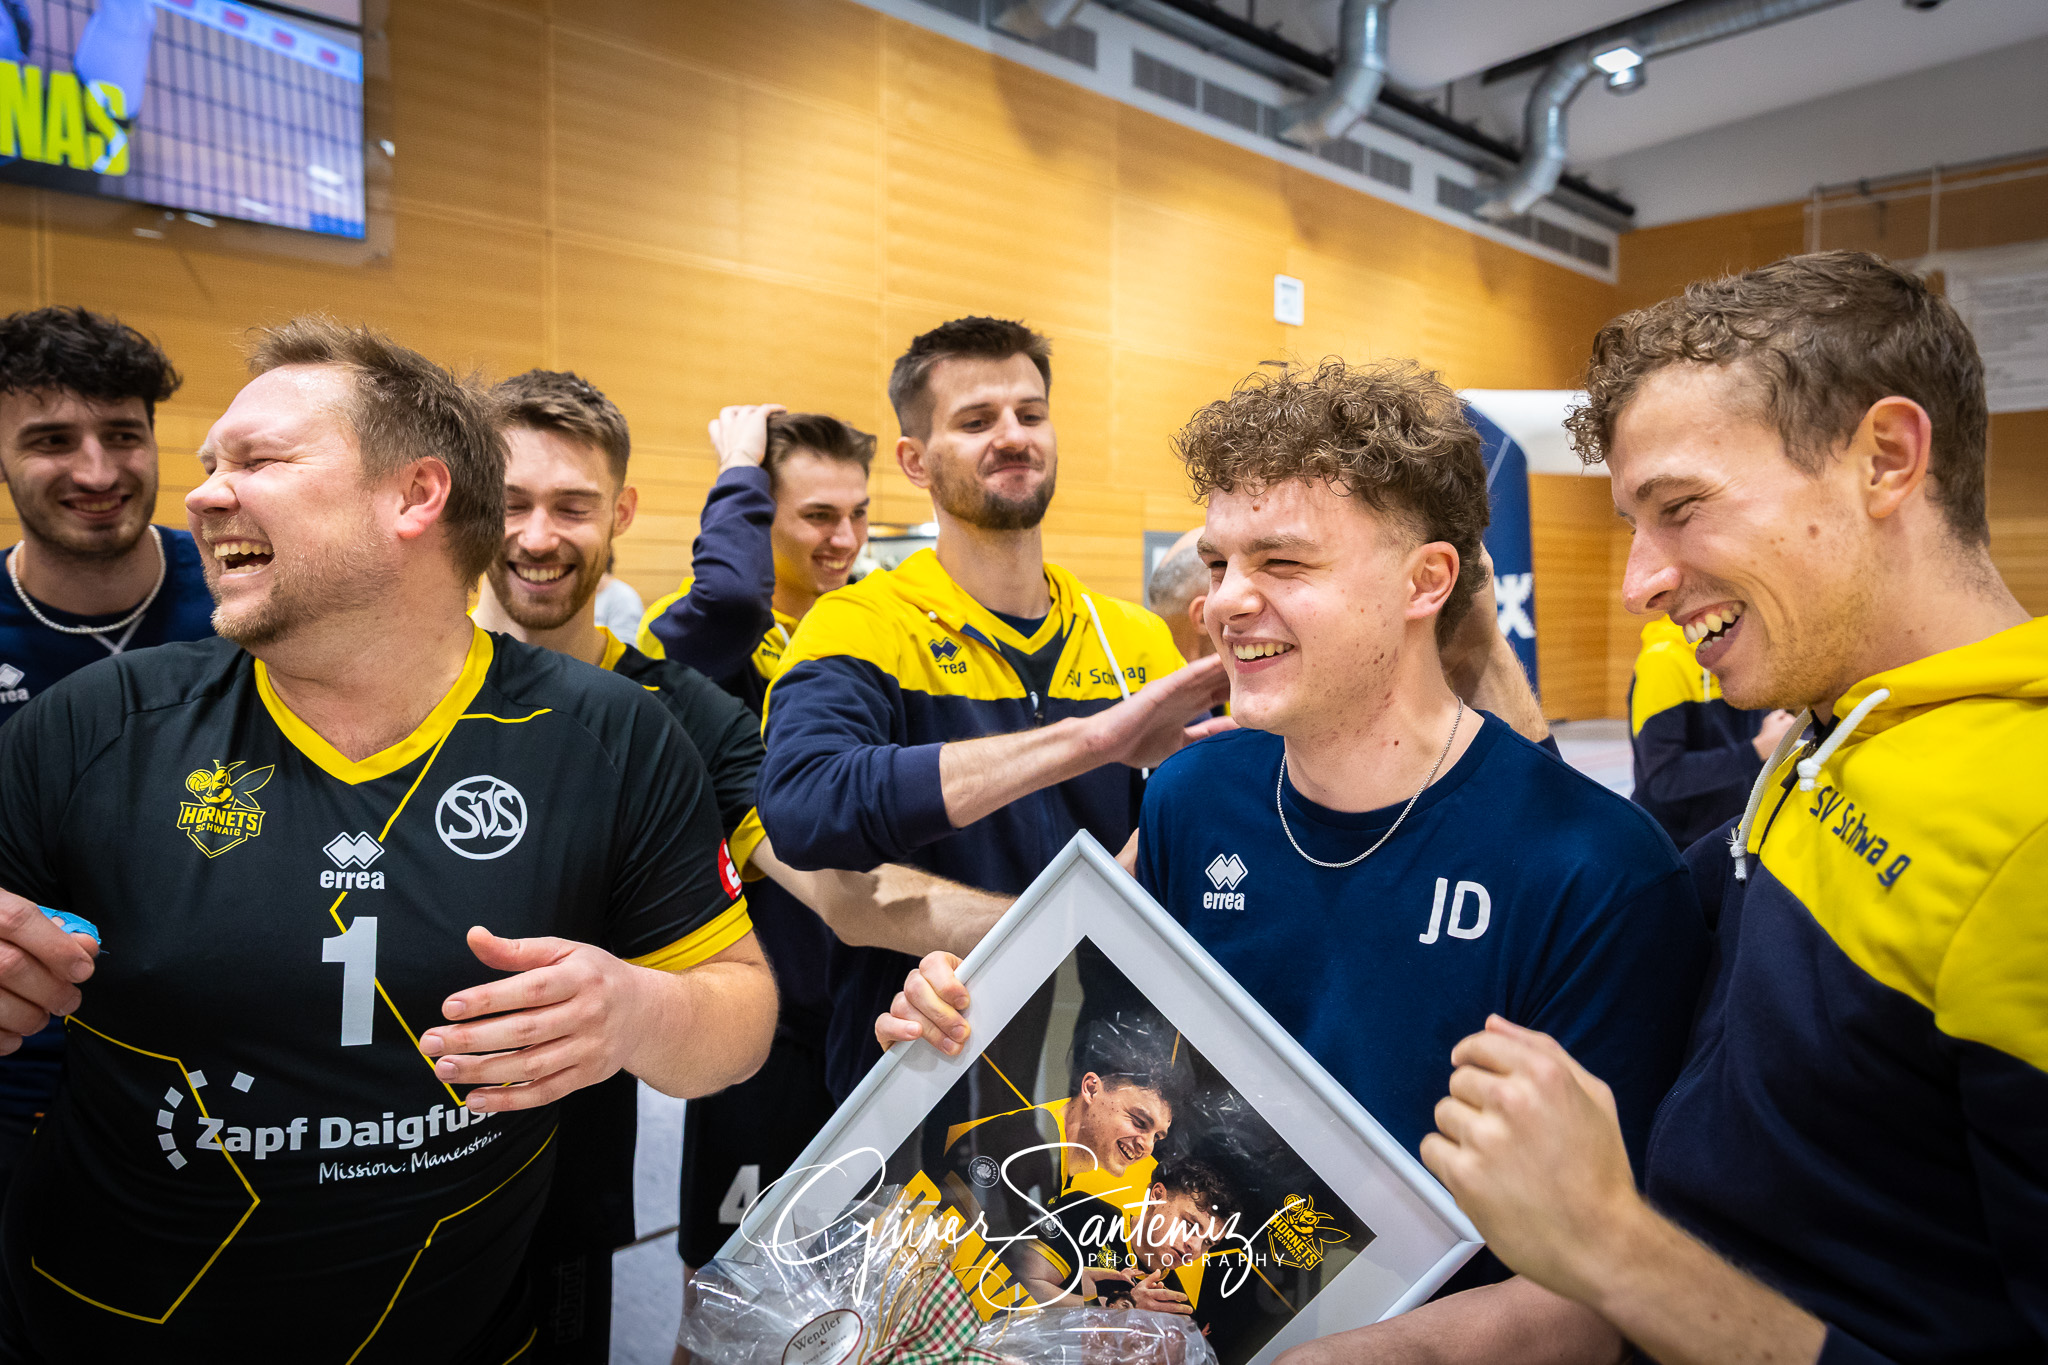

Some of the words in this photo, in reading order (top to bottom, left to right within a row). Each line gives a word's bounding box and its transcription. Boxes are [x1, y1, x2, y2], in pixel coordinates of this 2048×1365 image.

[181, 806, 259, 831] HORNETS
[447, 781, 524, 839] SVS
[1809, 785, 1845, 822] SV
[194, 822, 242, 836] SCHWAIG
[1419, 877, 1492, 945] JD
[321, 916, 378, 1047] 1
[196, 1116, 309, 1160] Zapf
[319, 1103, 499, 1151] Daigfus
[318, 1161, 407, 1184] Mission:
[718, 1164, 760, 1225] 4
[1269, 1214, 1318, 1267] HORNETS
[1273, 1231, 1303, 1262] SCHWAIG
[792, 1315, 841, 1352] Wendler
